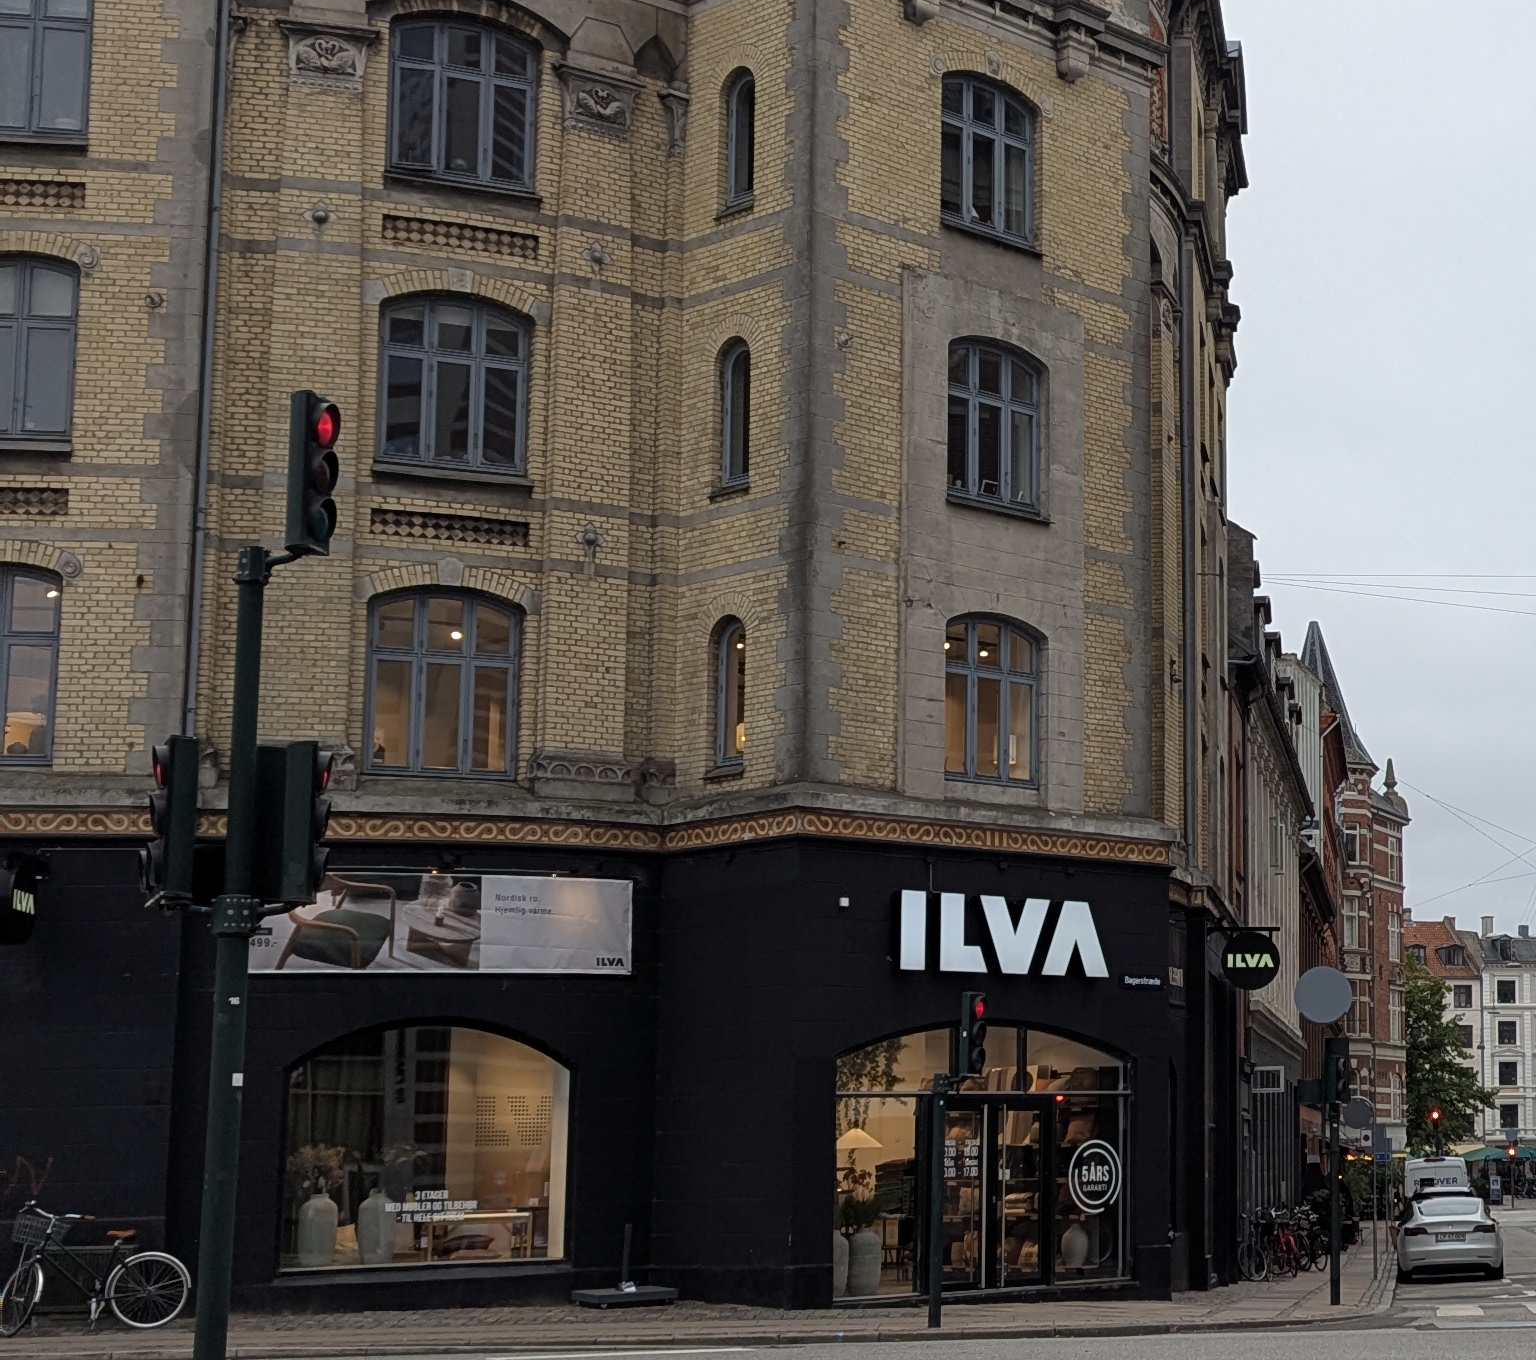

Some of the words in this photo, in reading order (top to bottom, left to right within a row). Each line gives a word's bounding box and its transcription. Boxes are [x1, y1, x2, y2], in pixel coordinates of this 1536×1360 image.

[13, 888, 35, 915] ILVA
[495, 893, 527, 902] Nordisk
[900, 889, 1110, 978] ILVA
[596, 957, 625, 967] ILVA
[1227, 953, 1275, 968] ILVA
